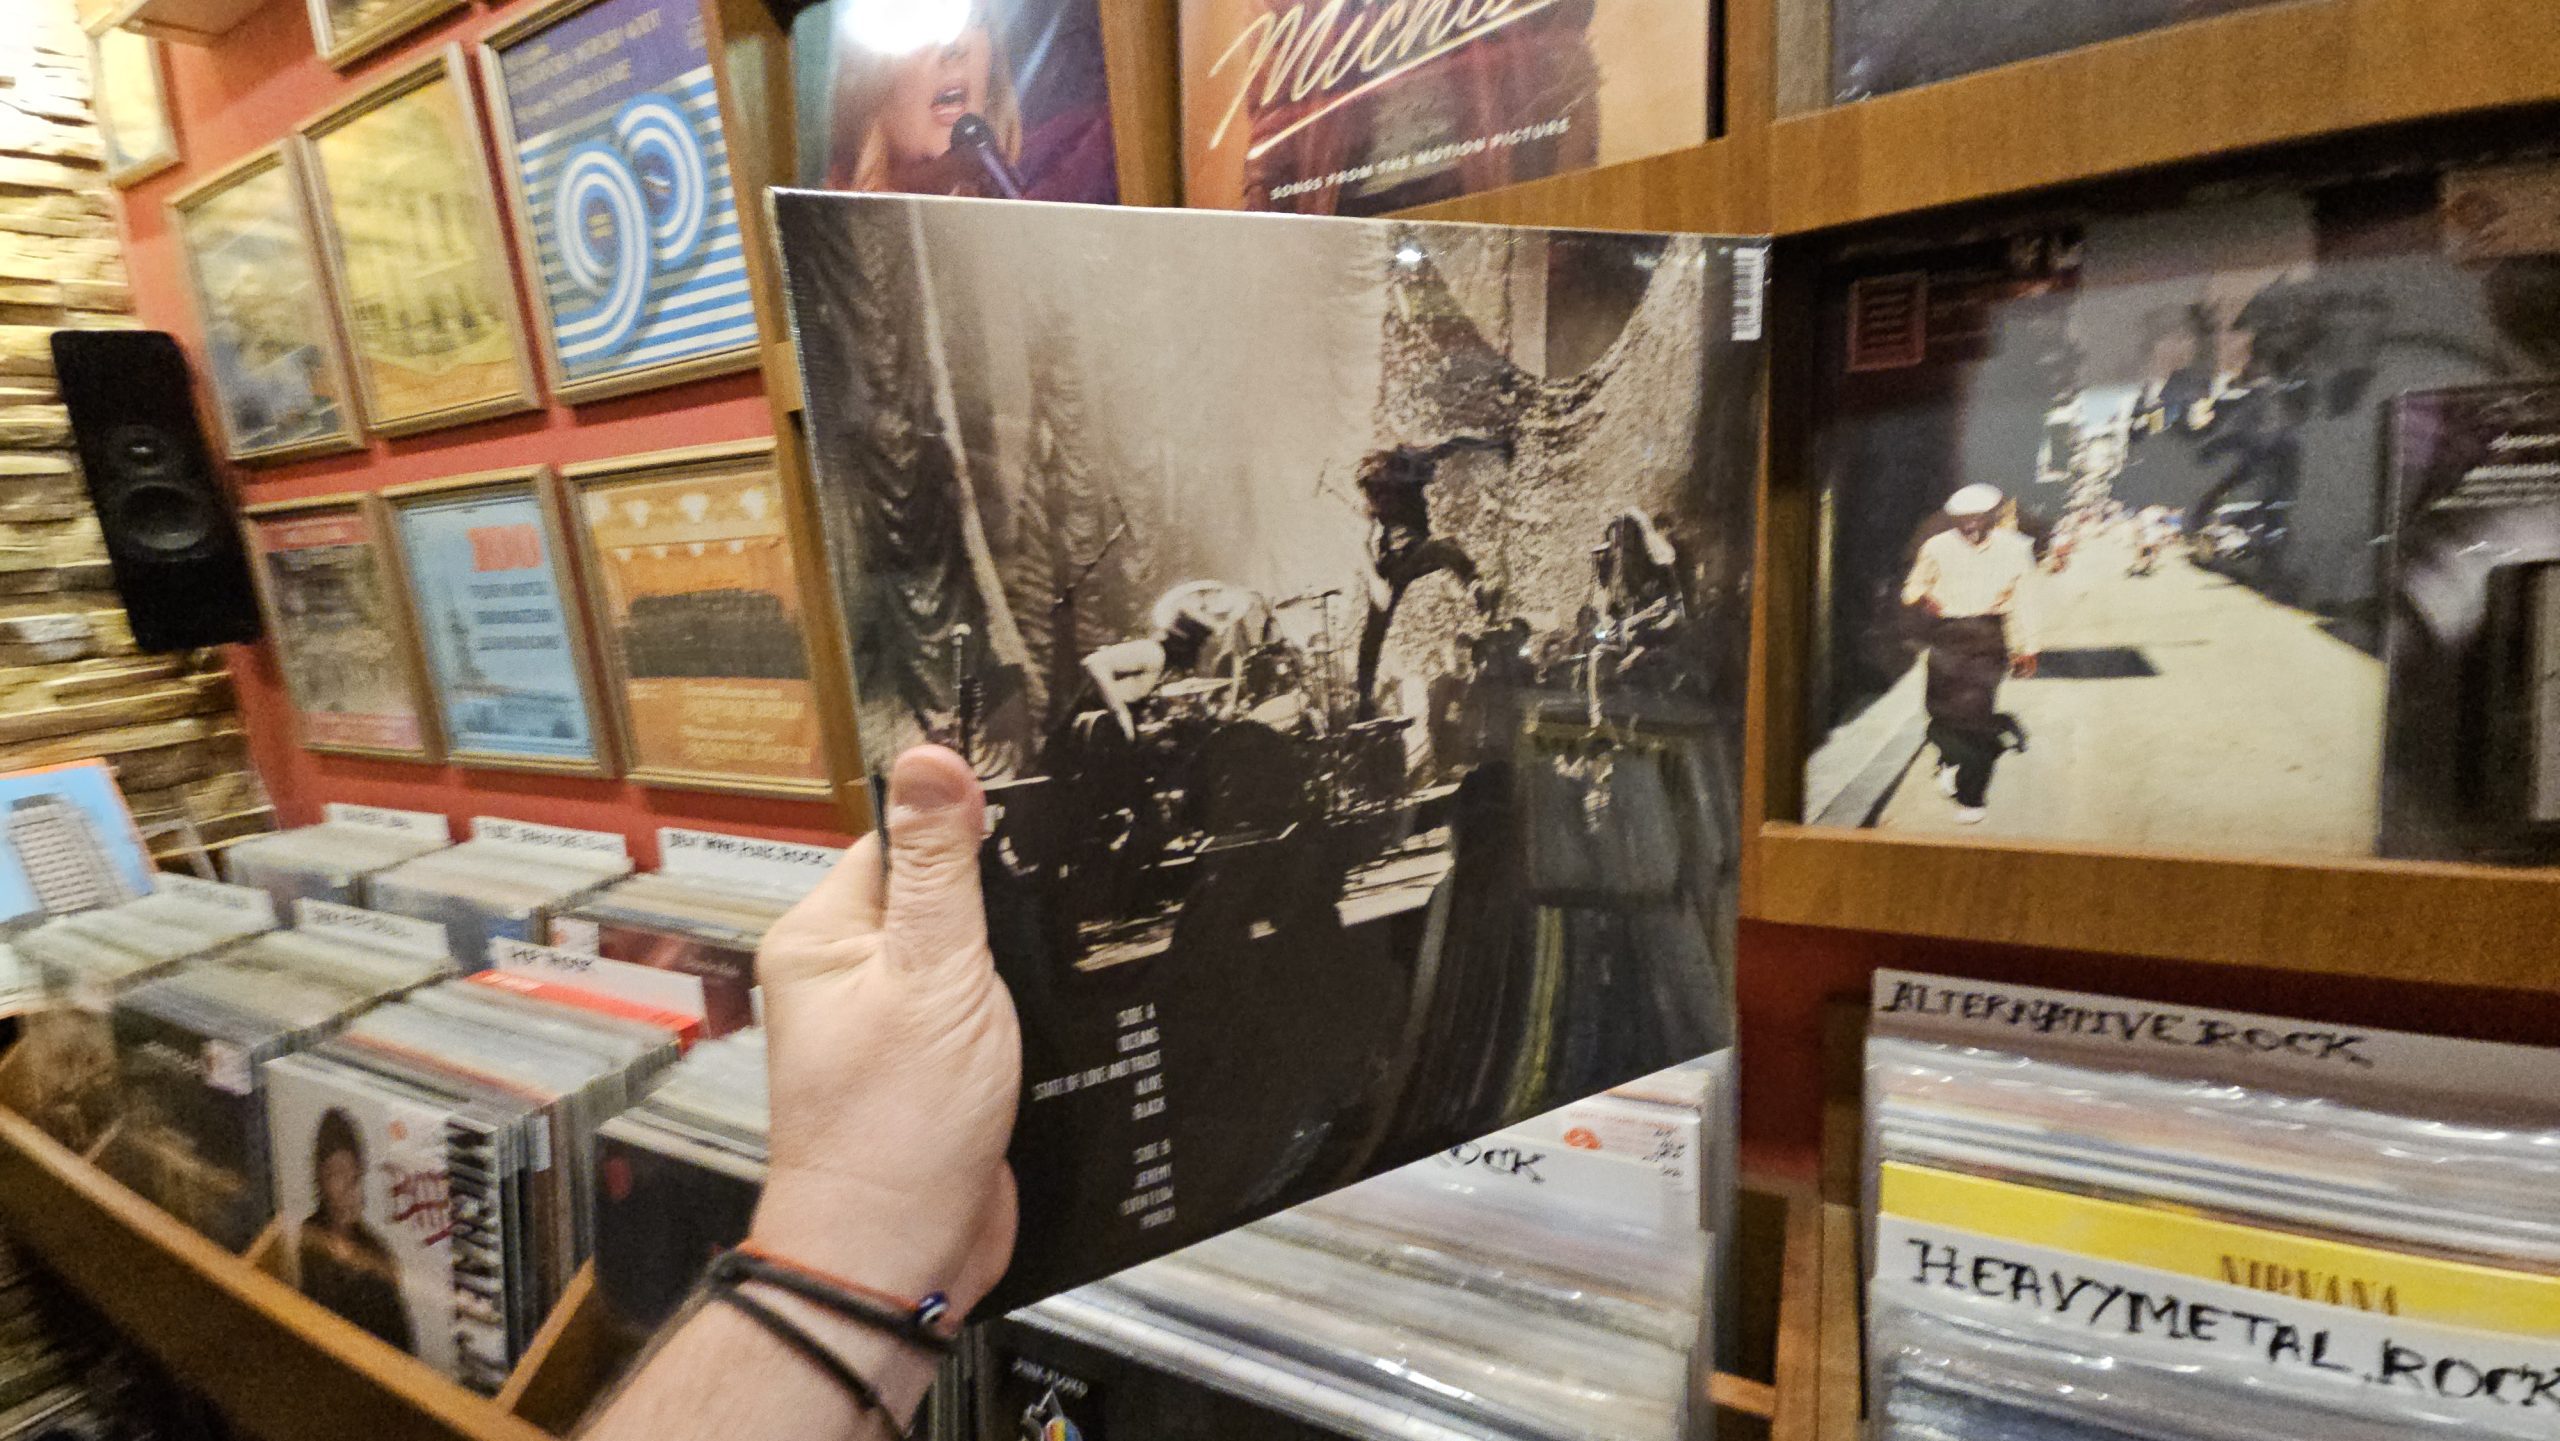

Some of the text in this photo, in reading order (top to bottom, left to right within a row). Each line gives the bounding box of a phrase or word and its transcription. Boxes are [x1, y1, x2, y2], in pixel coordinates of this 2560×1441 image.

[1269, 115, 1572, 200] SONGS FROM THE MOTION PICTURE
[1116, 1005, 1144, 1028] SIDE
[1880, 980, 2374, 1069] ALTERNATIVE ROCK
[1130, 1049, 1161, 1074] TRUST
[2219, 1254, 2399, 1318] NIRVANA
